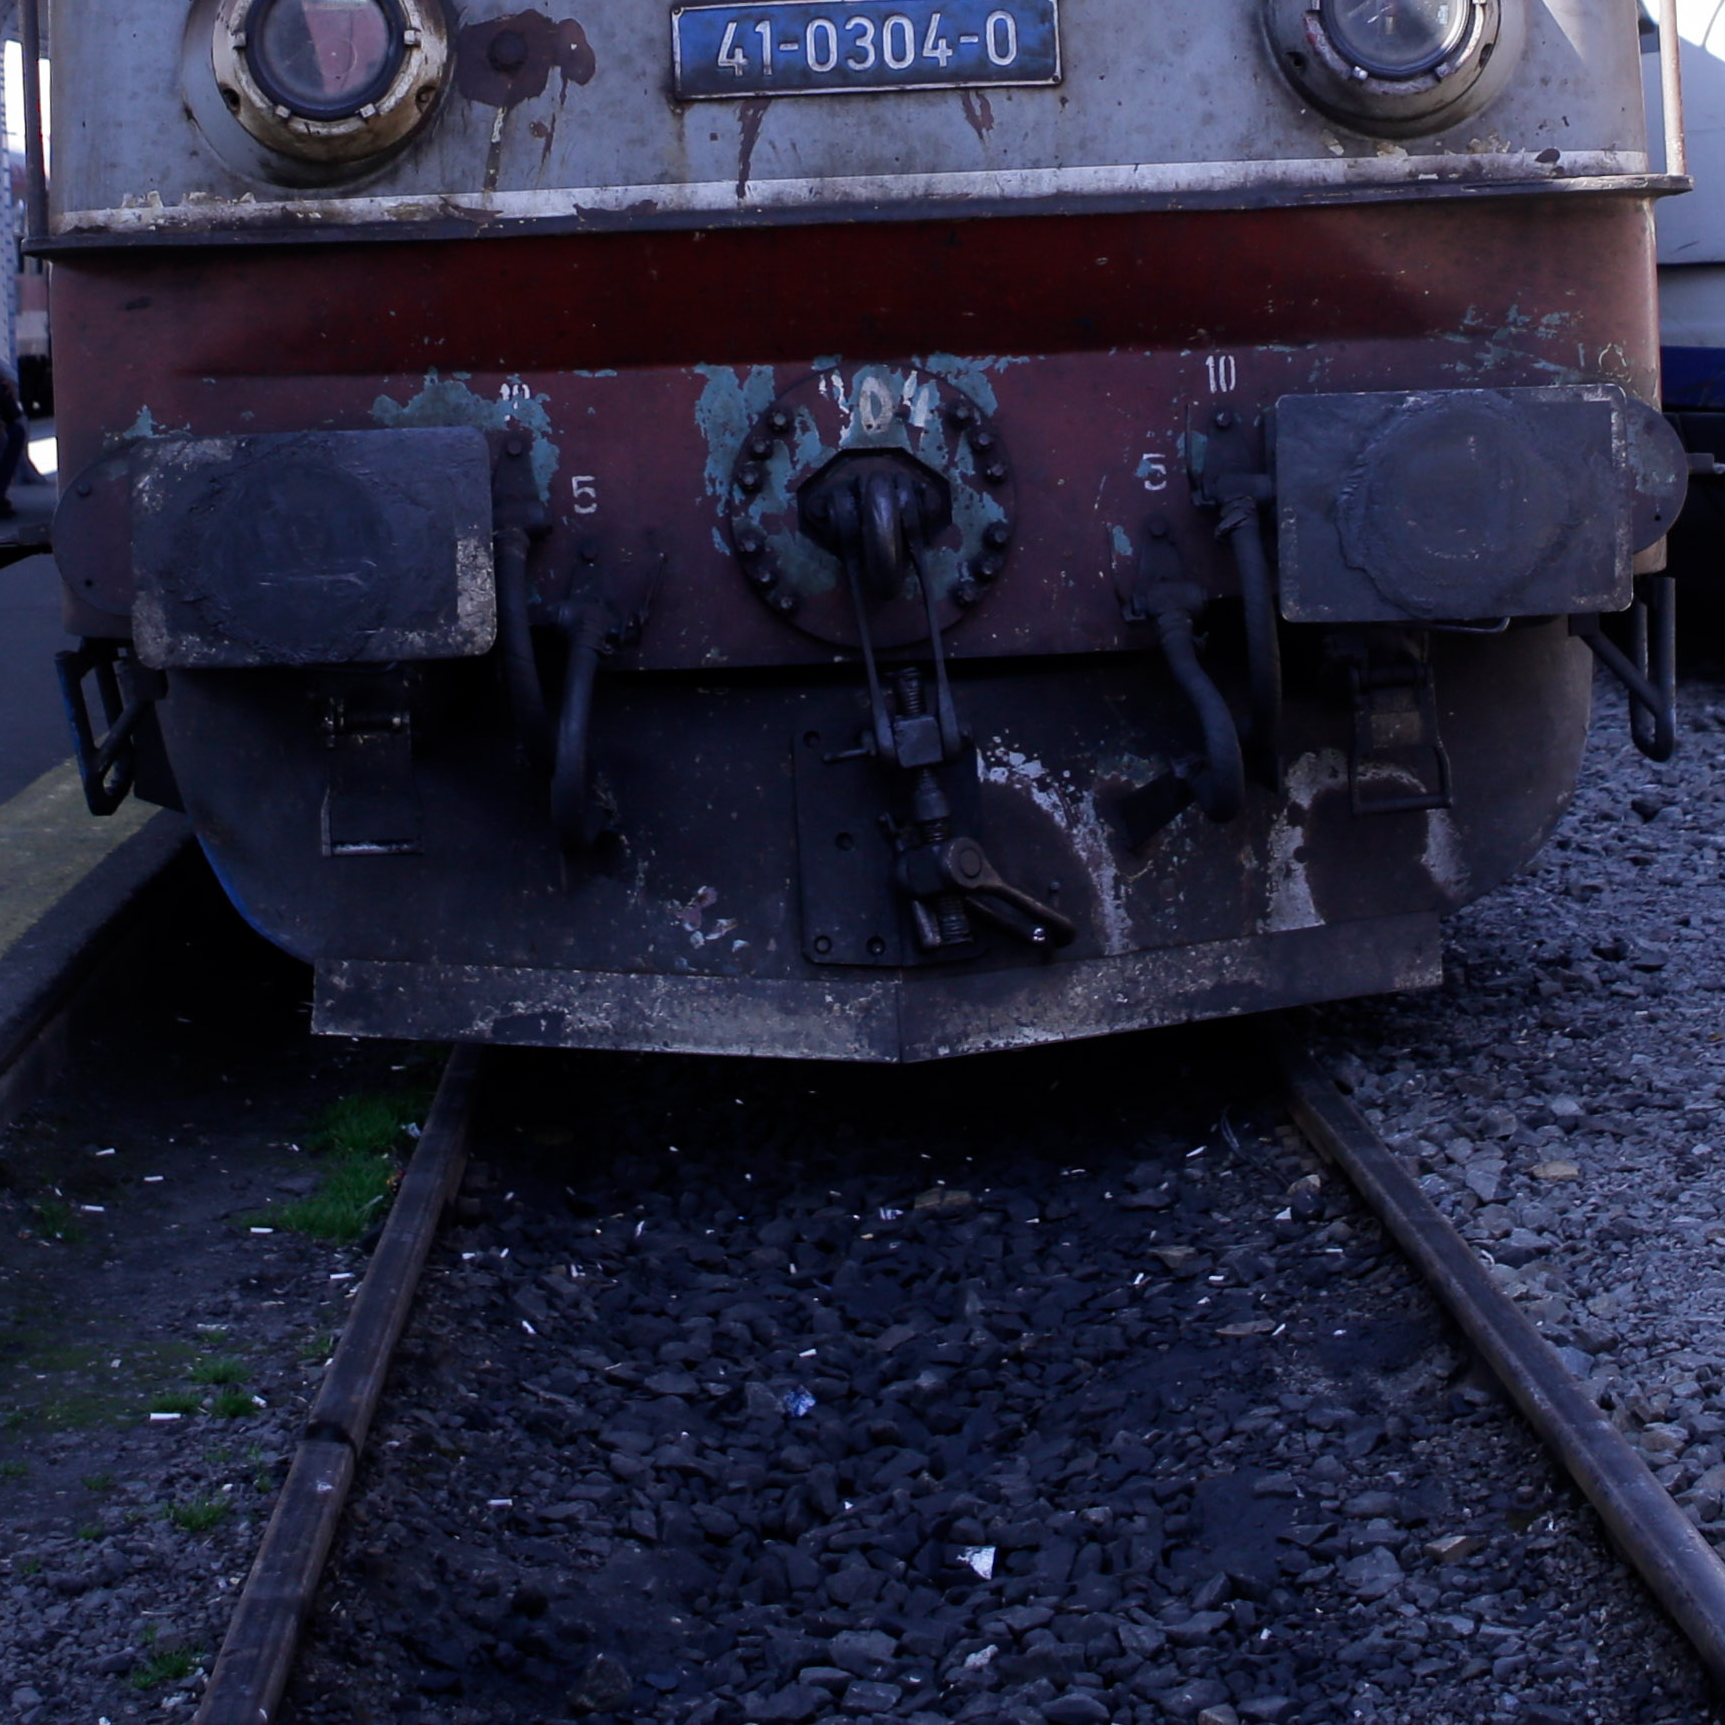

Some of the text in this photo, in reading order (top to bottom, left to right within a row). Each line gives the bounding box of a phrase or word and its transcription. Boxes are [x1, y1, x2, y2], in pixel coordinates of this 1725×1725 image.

[716, 9, 1019, 78] 41-0304-0
[1205, 354, 1236, 394] 10
[1141, 453, 1168, 491] 5
[571, 475, 598, 514] 5
